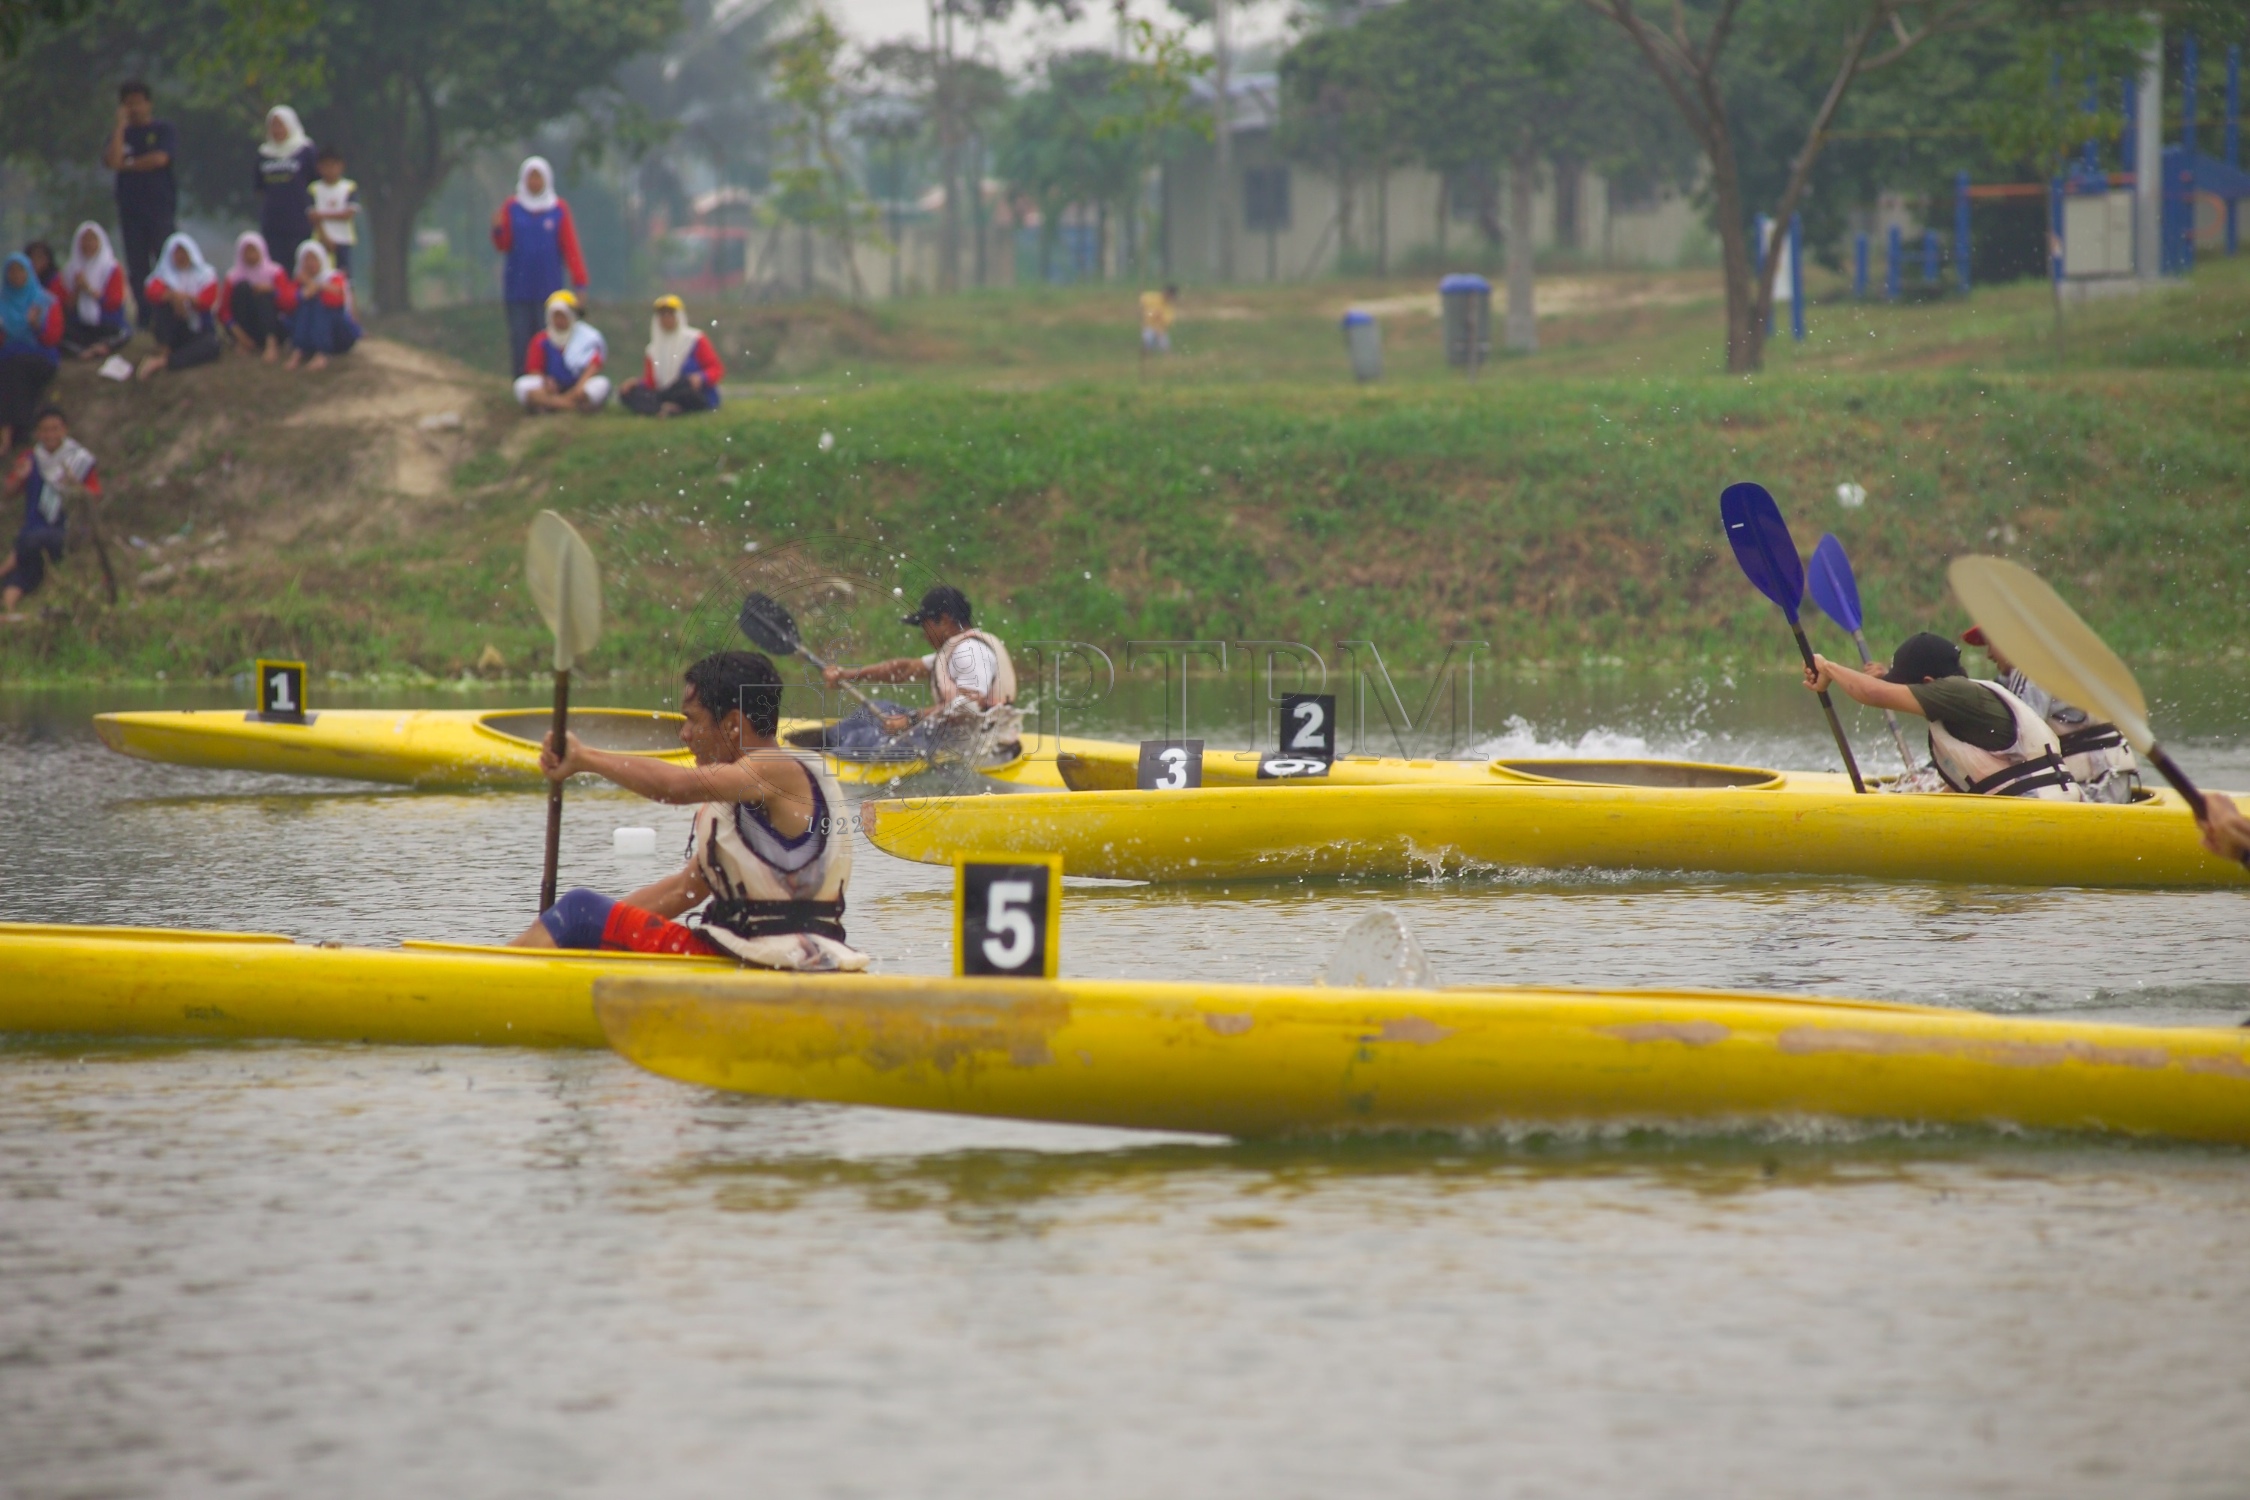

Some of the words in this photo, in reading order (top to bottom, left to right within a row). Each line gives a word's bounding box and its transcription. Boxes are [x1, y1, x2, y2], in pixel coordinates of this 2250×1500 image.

[269, 671, 295, 711] 1
[1291, 701, 1325, 748] 2
[1156, 747, 1187, 790] 3
[982, 881, 1035, 970] 5
